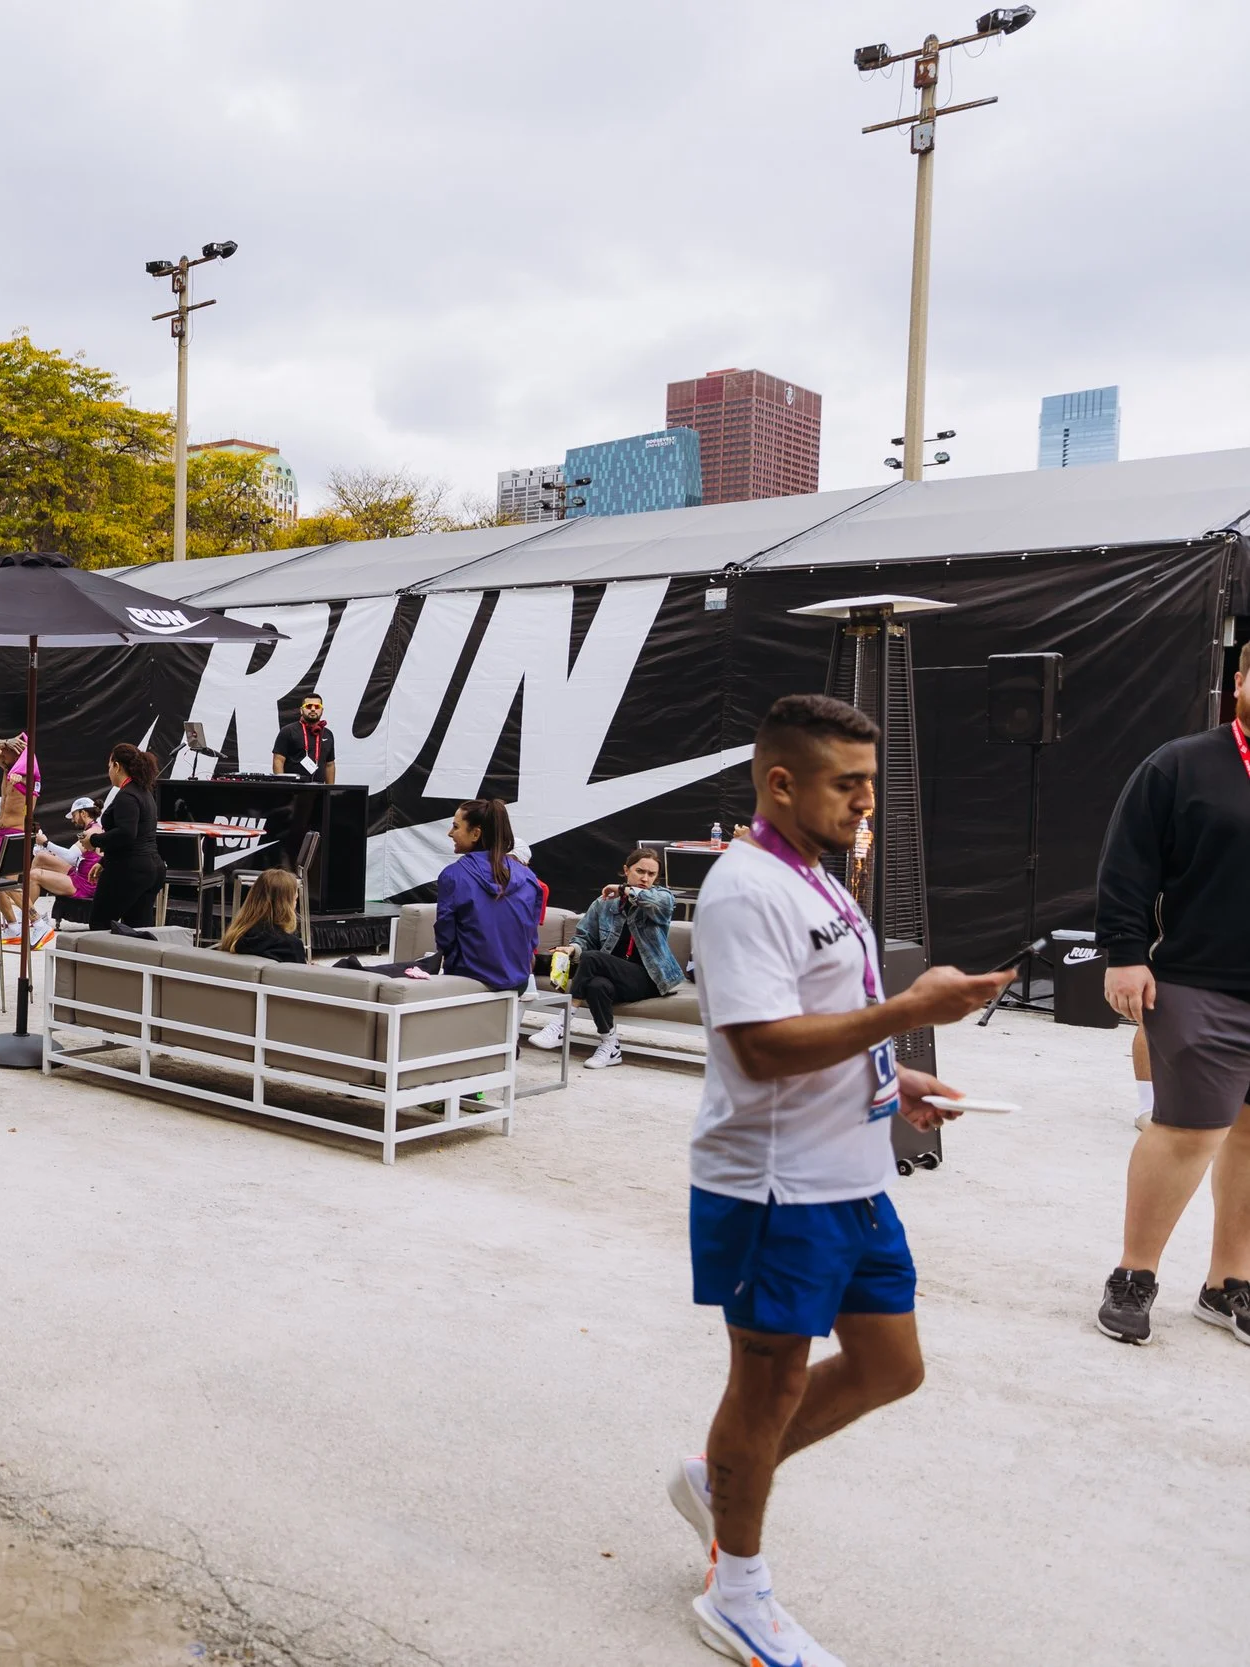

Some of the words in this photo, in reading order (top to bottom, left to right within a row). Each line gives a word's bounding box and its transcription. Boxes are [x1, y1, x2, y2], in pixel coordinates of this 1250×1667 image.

[125, 607, 190, 626] RUN
[170, 577, 670, 800] RUN
[1070, 947, 1097, 958] RUN
